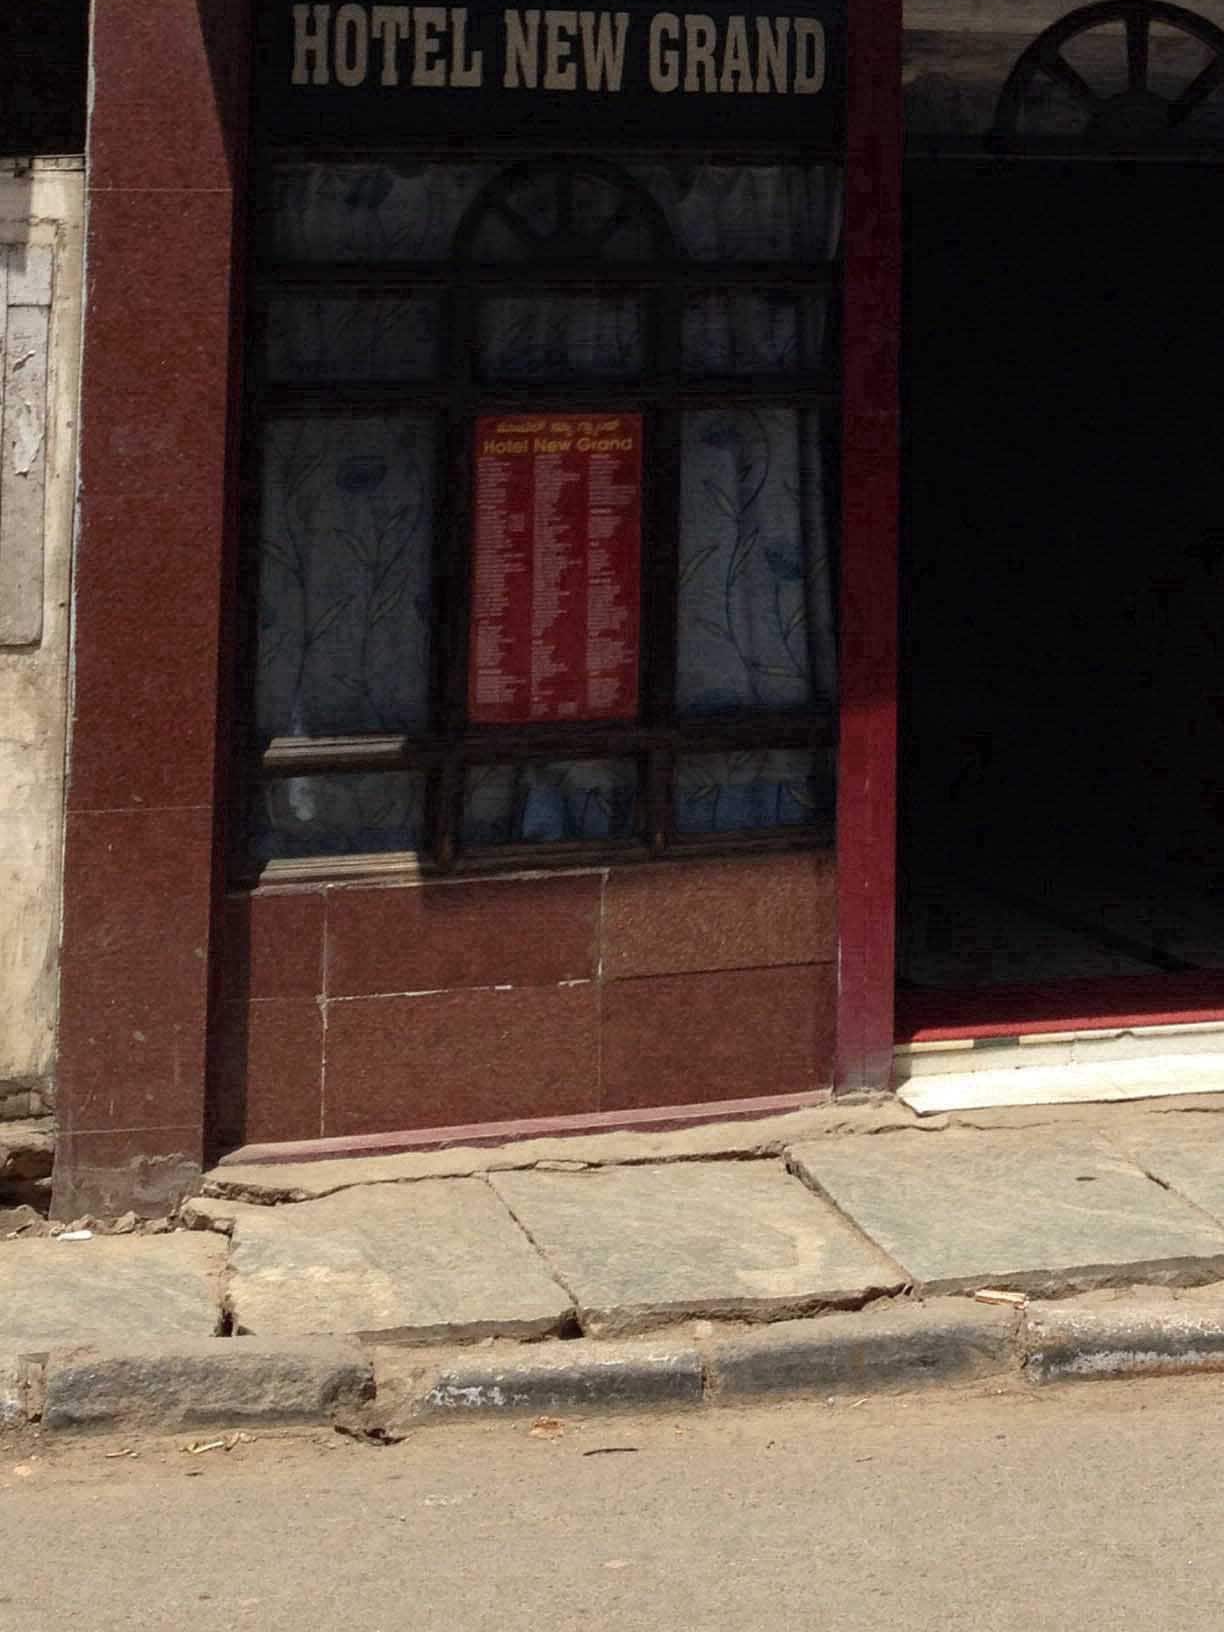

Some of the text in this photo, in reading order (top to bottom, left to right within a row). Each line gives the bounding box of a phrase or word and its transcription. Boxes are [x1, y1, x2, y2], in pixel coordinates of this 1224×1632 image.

[290, 3, 826, 96] HOTEL NEW GRAND
[482, 436, 633, 455] Hotel New Grand
